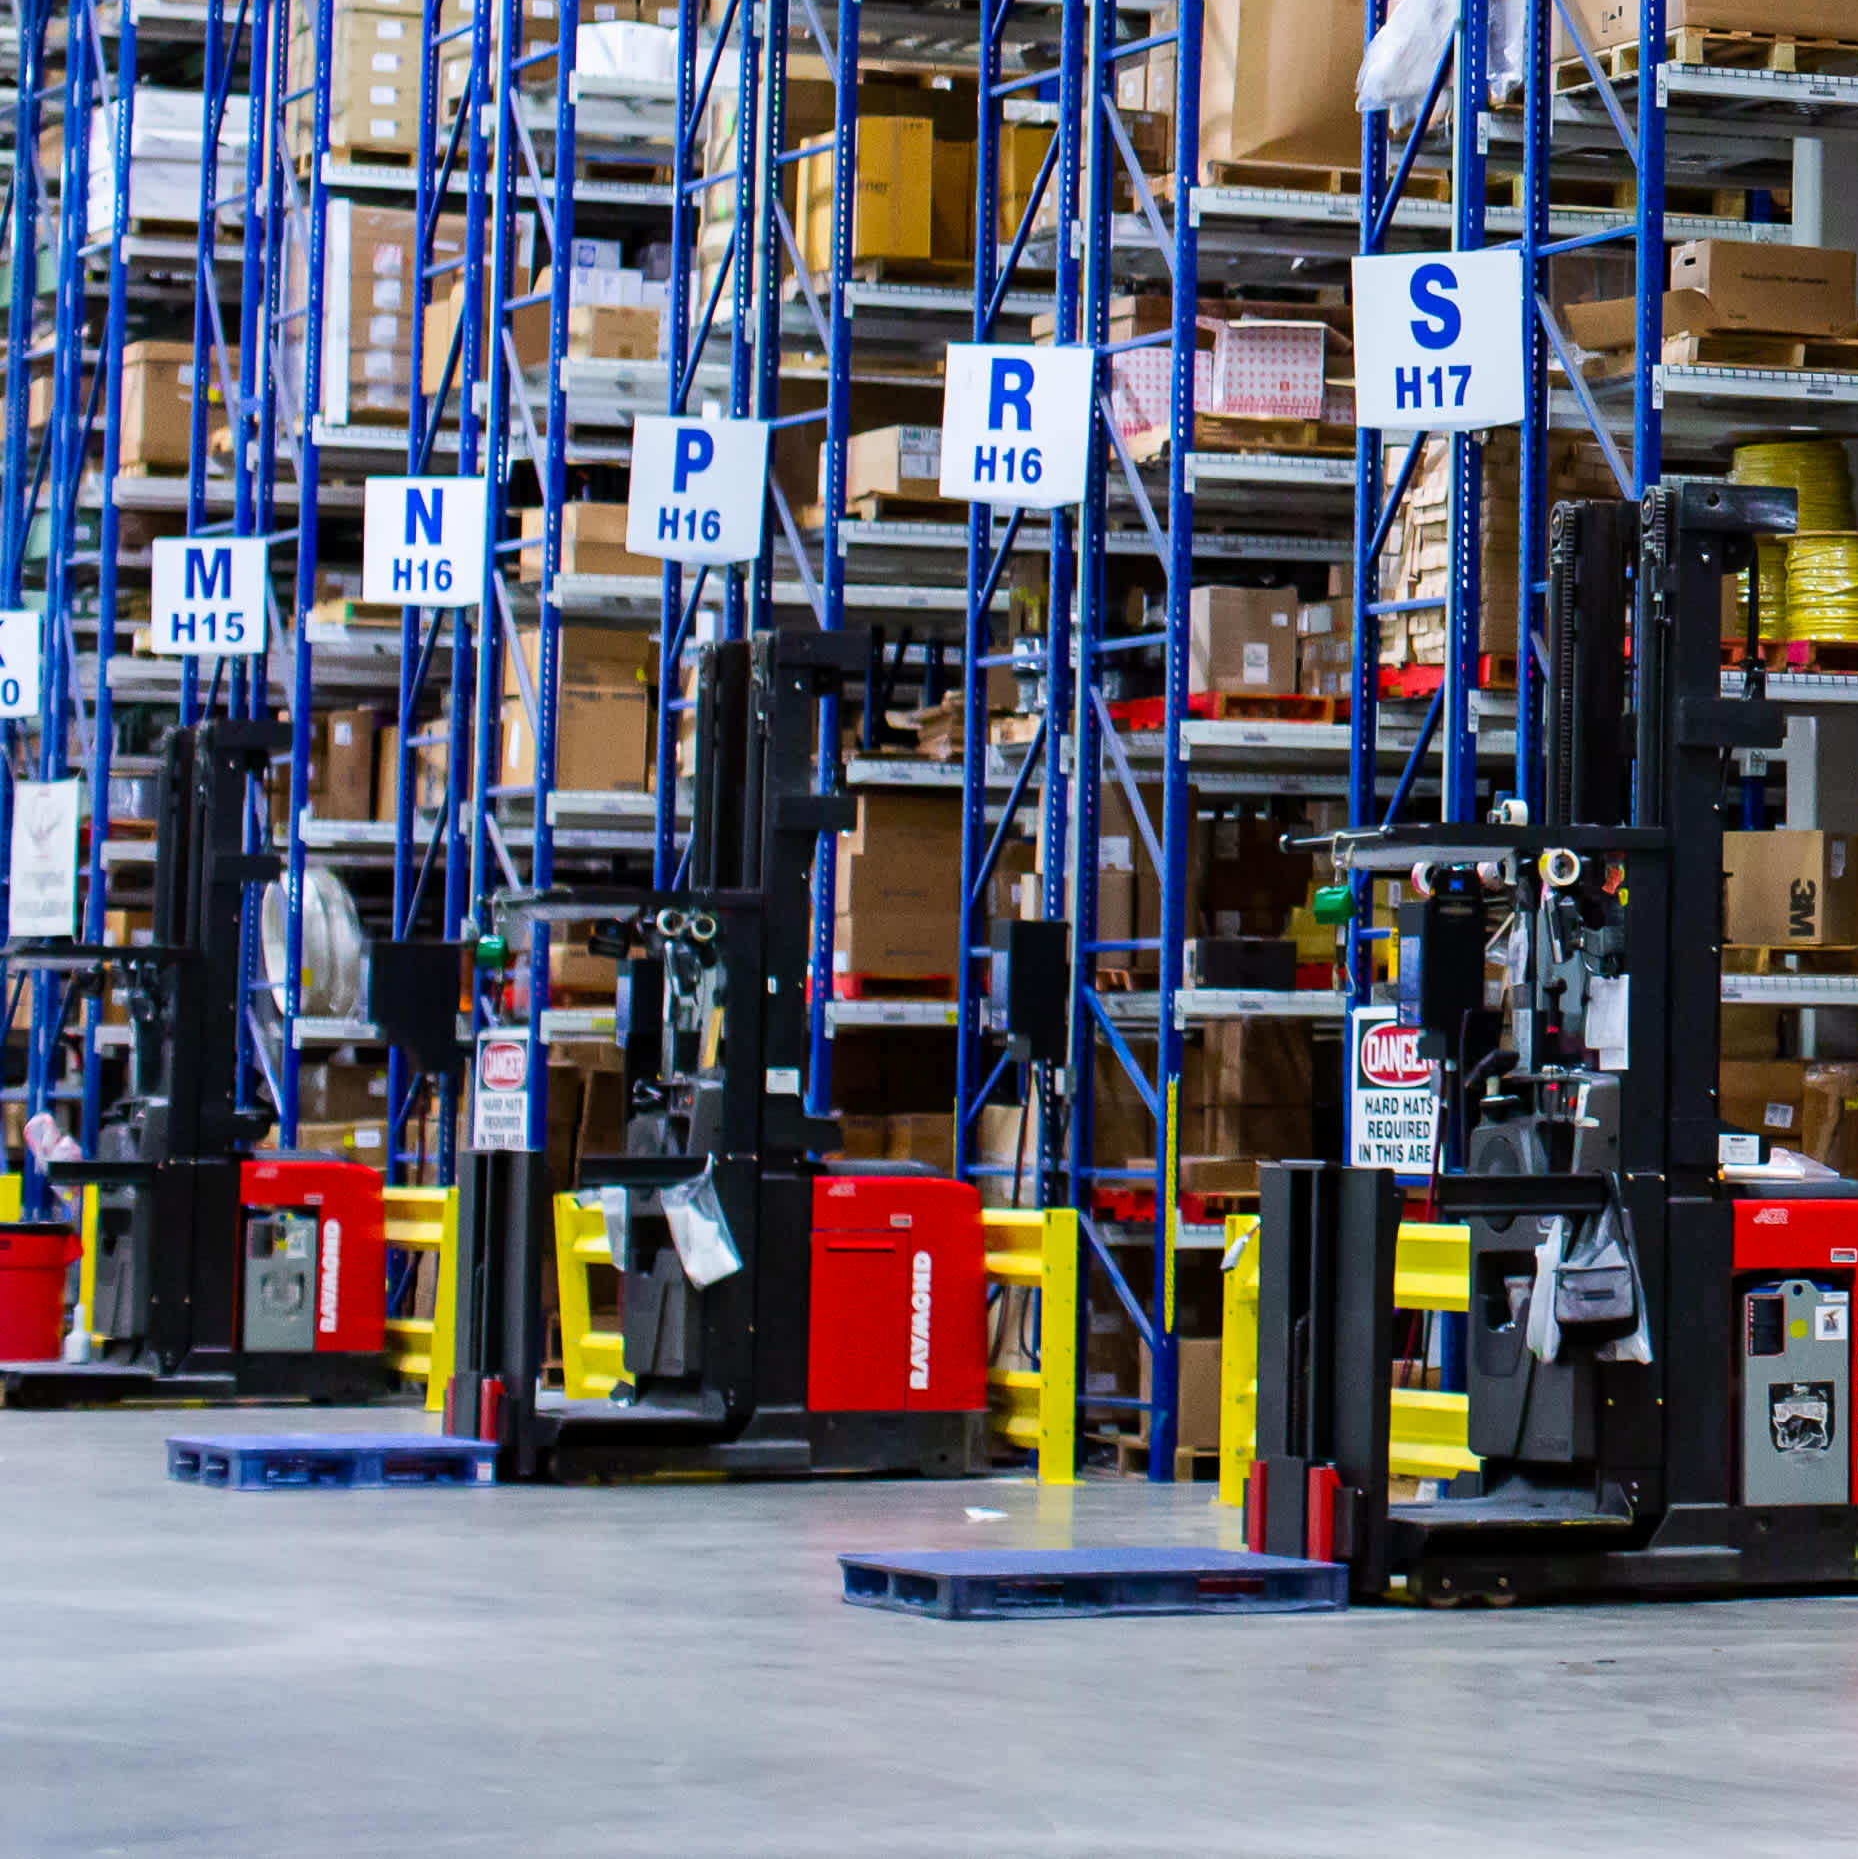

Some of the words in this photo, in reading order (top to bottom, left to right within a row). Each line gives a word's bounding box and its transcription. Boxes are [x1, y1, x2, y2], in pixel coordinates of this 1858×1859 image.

[1408, 261, 1463, 350] S
[988, 358, 1035, 432] R
[1395, 364, 1473, 410] H17
[672, 427, 716, 494] P
[973, 446, 1044, 485] H16
[403, 487, 445, 546] N
[656, 505, 723, 543] H16
[184, 546, 232, 601] M
[391, 558, 454, 594] H16
[170, 612, 246, 646] H15
[1790, 877, 1816, 937] 3M
[1364, 1096, 1400, 1116] HARD
[1403, 1095, 1434, 1116] HATS
[1367, 1120, 1431, 1140] REQUIRED
[1358, 1143, 1372, 1163] IN
[1375, 1143, 1405, 1163] THIS
[1407, 1143, 1432, 1163] ARE
[319, 1218, 341, 1334] RAYMOND
[910, 1251, 932, 1390] RAYMOND
